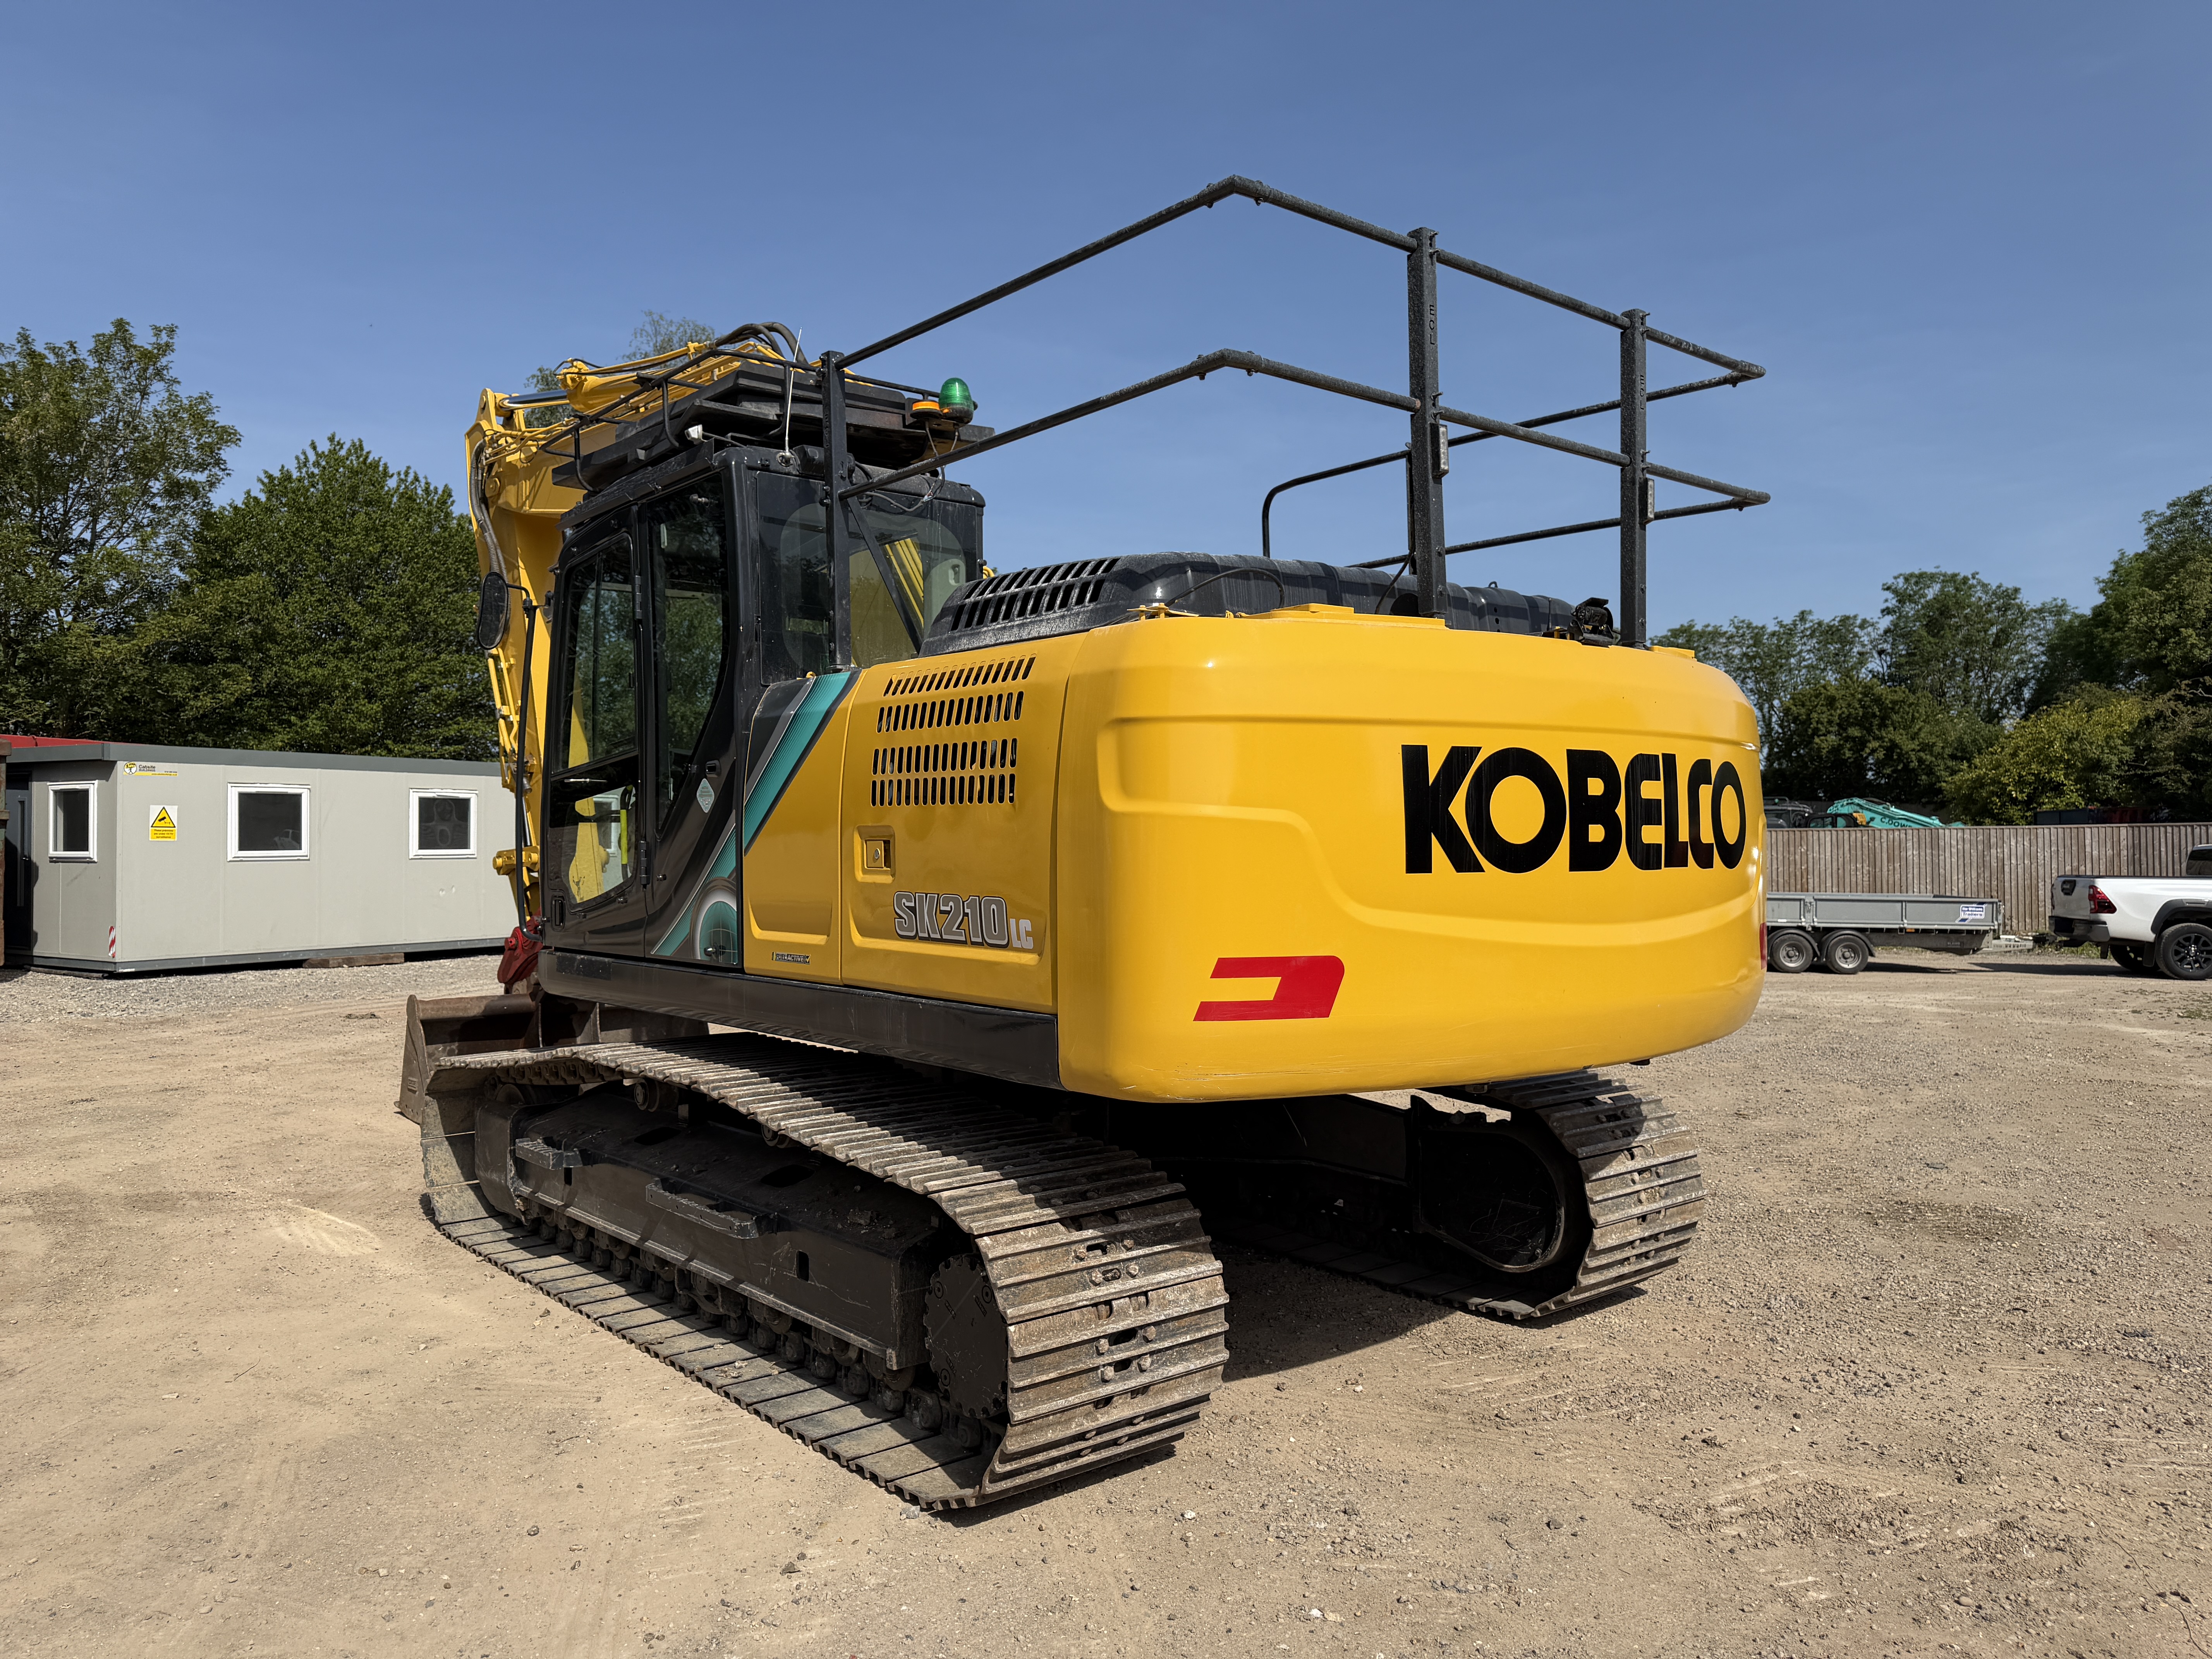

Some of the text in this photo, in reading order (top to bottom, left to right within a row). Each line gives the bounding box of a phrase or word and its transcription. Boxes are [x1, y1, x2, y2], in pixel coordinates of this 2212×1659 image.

[1401, 744, 1746, 874] KOBELCO
[893, 891, 1034, 949] SK210 LC
[787, 954, 805, 963] ACTIVE
